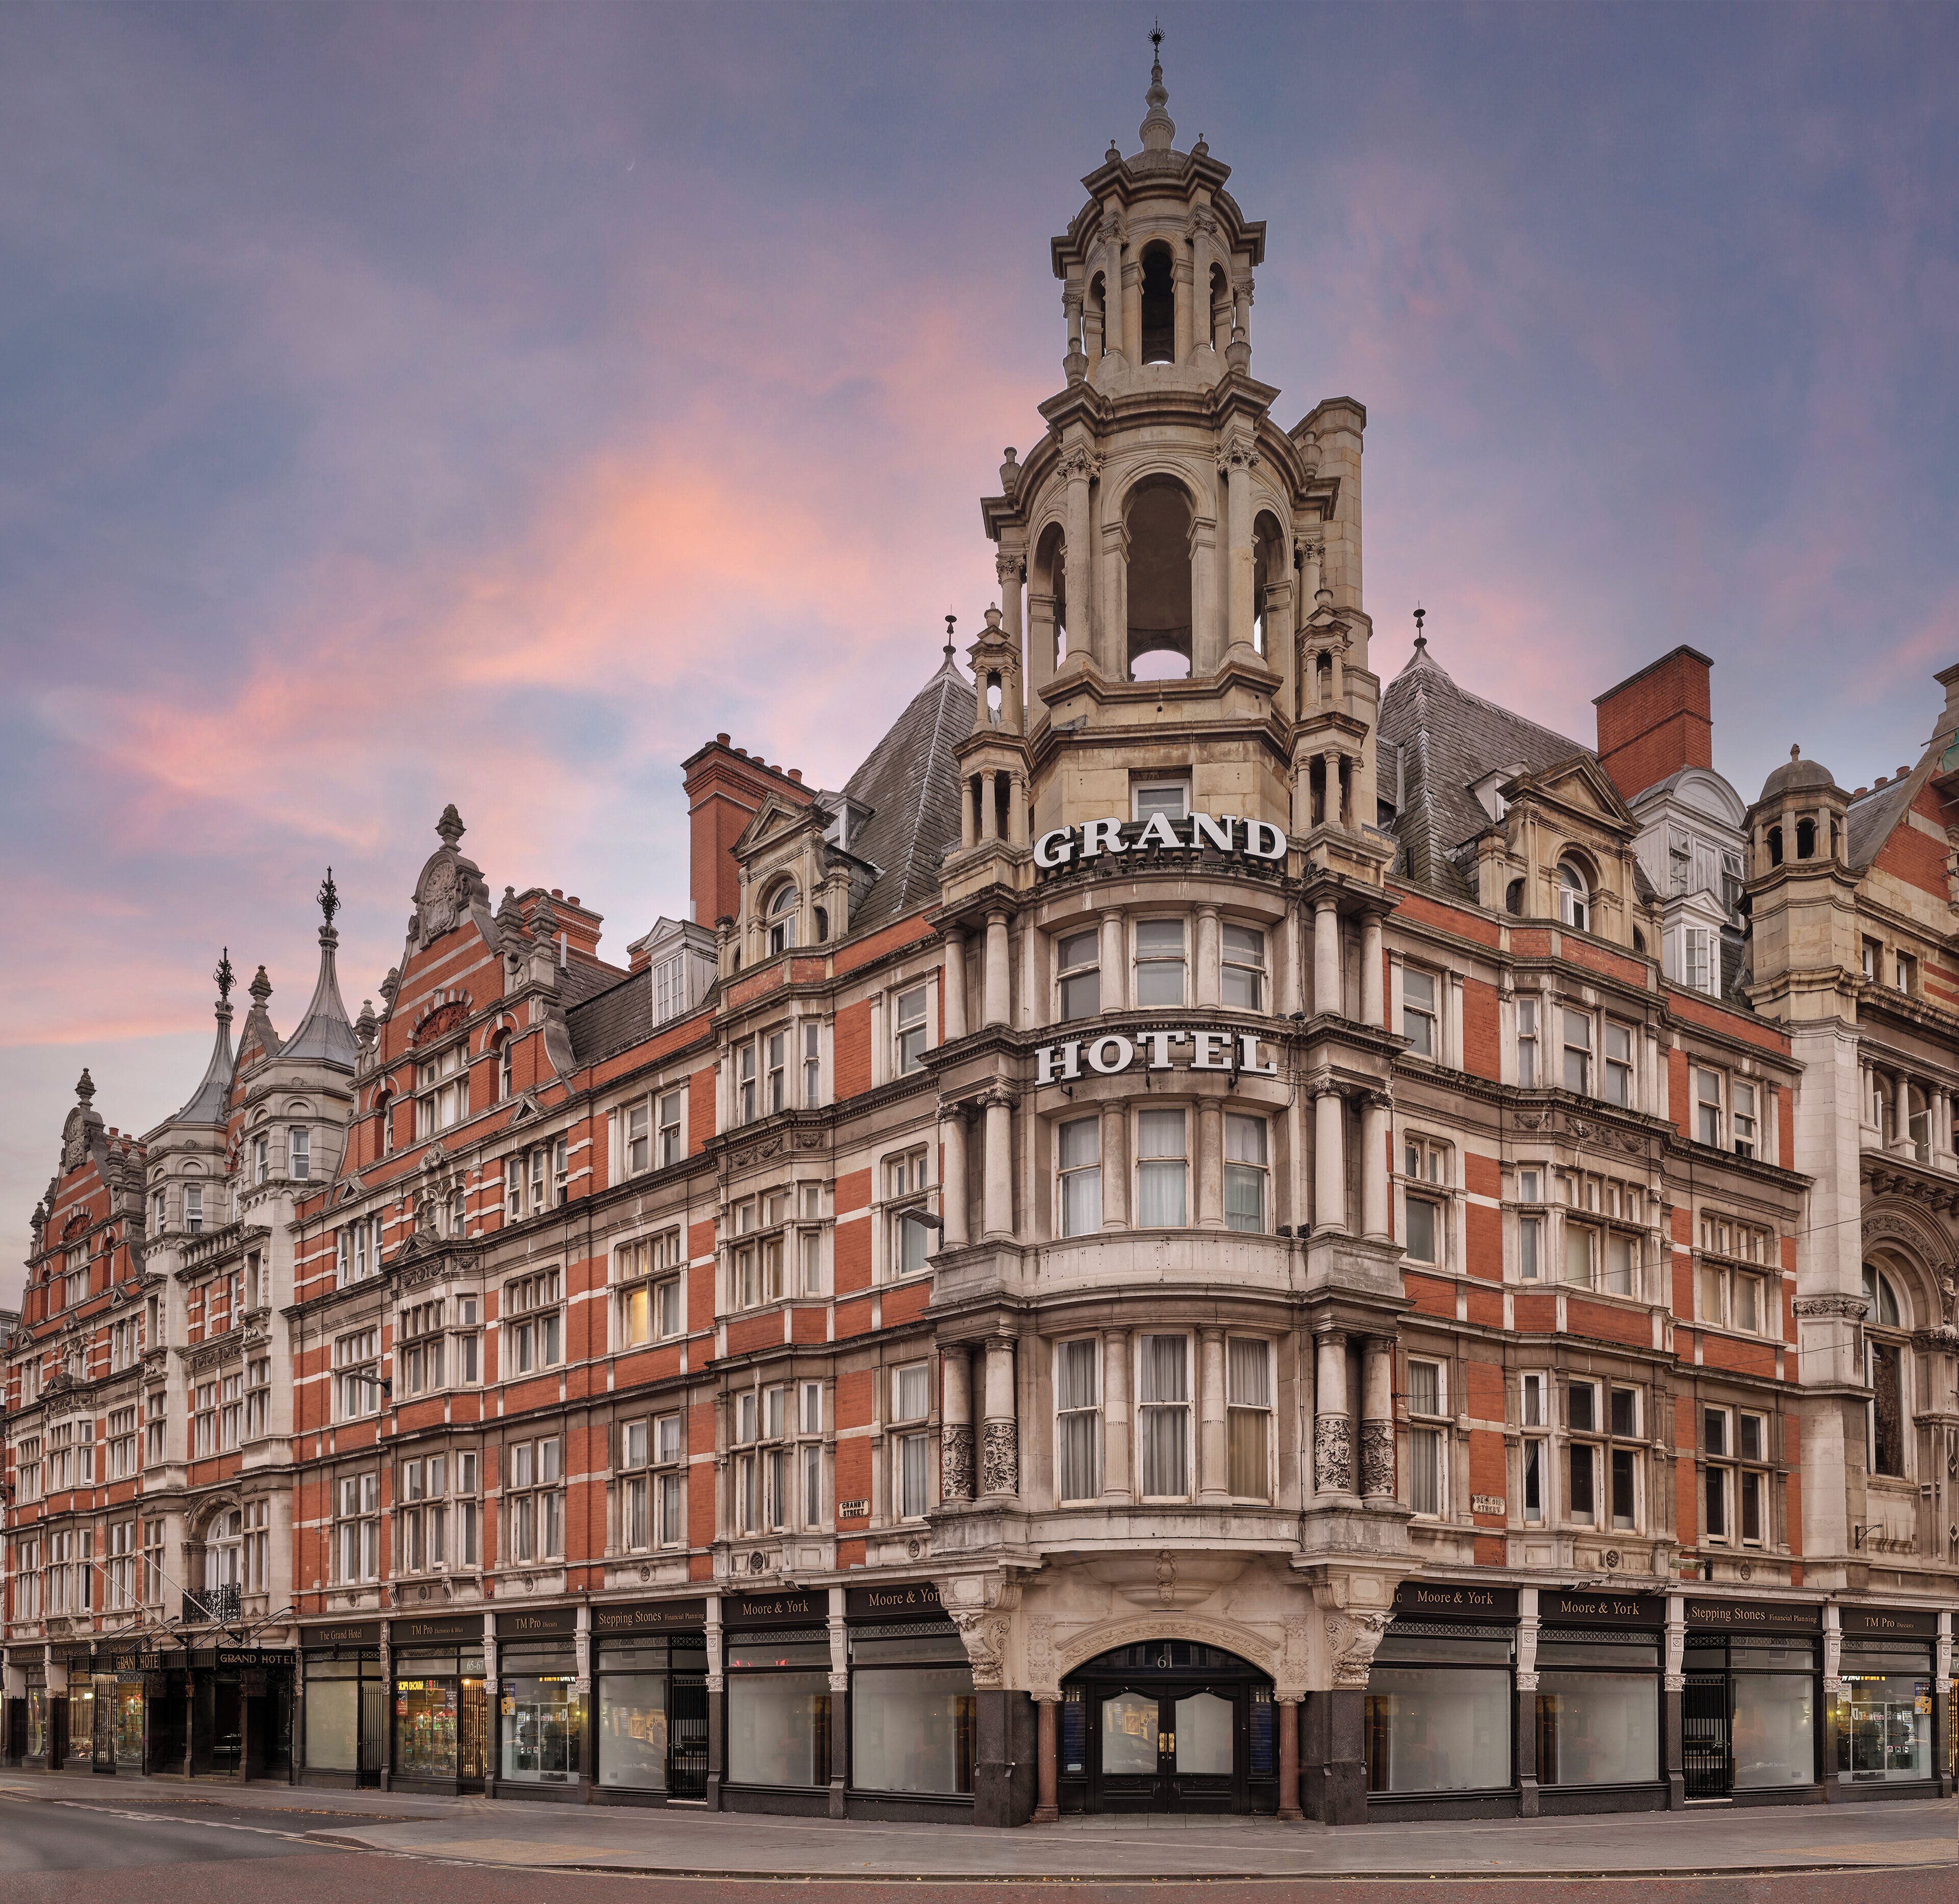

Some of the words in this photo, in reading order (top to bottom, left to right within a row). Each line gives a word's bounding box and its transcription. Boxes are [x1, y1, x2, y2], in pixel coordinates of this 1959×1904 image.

[1033, 811, 1288, 868] GRAND
[1035, 1030, 1278, 1086] HOTEL
[868, 1593, 903, 1607] Moore
[907, 1590, 916, 1603] &
[920, 1589, 939, 1602] Yor
[1417, 1590, 1451, 1603] Moore
[1454, 1591, 1463, 1603] &
[1468, 1592, 1494, 1605] York
[743, 1603, 772, 1615] Moore
[775, 1602, 783, 1613] &
[787, 1600, 809, 1613] York
[1561, 1601, 1595, 1613] Moore
[1598, 1602, 1608, 1614] &
[1613, 1602, 1640, 1615] York
[599, 1612, 633, 1627] Stepping
[636, 1611, 662, 1622] Stones
[1692, 1606, 1732, 1622] Stepping
[1735, 1608, 1766, 1620] Stones
[1769, 1614, 1792, 1622] Financial
[1794, 1615, 1818, 1624] Planning
[411, 1625, 421, 1635] TM
[423, 1624, 433, 1635] Pro
[515, 1618, 528, 1629] TM
[530, 1617, 541, 1628] Pro
[1865, 1617, 1879, 1627] TM
[1882, 1617, 1895, 1628] Pro
[319, 1631, 330, 1640] The
[331, 1630, 347, 1640] Grand
[348, 1629, 362, 1639] Hotel
[116, 1656, 135, 1669] GRAN
[139, 1655, 159, 1668] HOTE
[220, 1654, 257, 1663] GRAND
[262, 1655, 297, 1664] HOTEL
[466, 1660, 484, 1671] 65-67
[1157, 1654, 1174, 1668] 61
